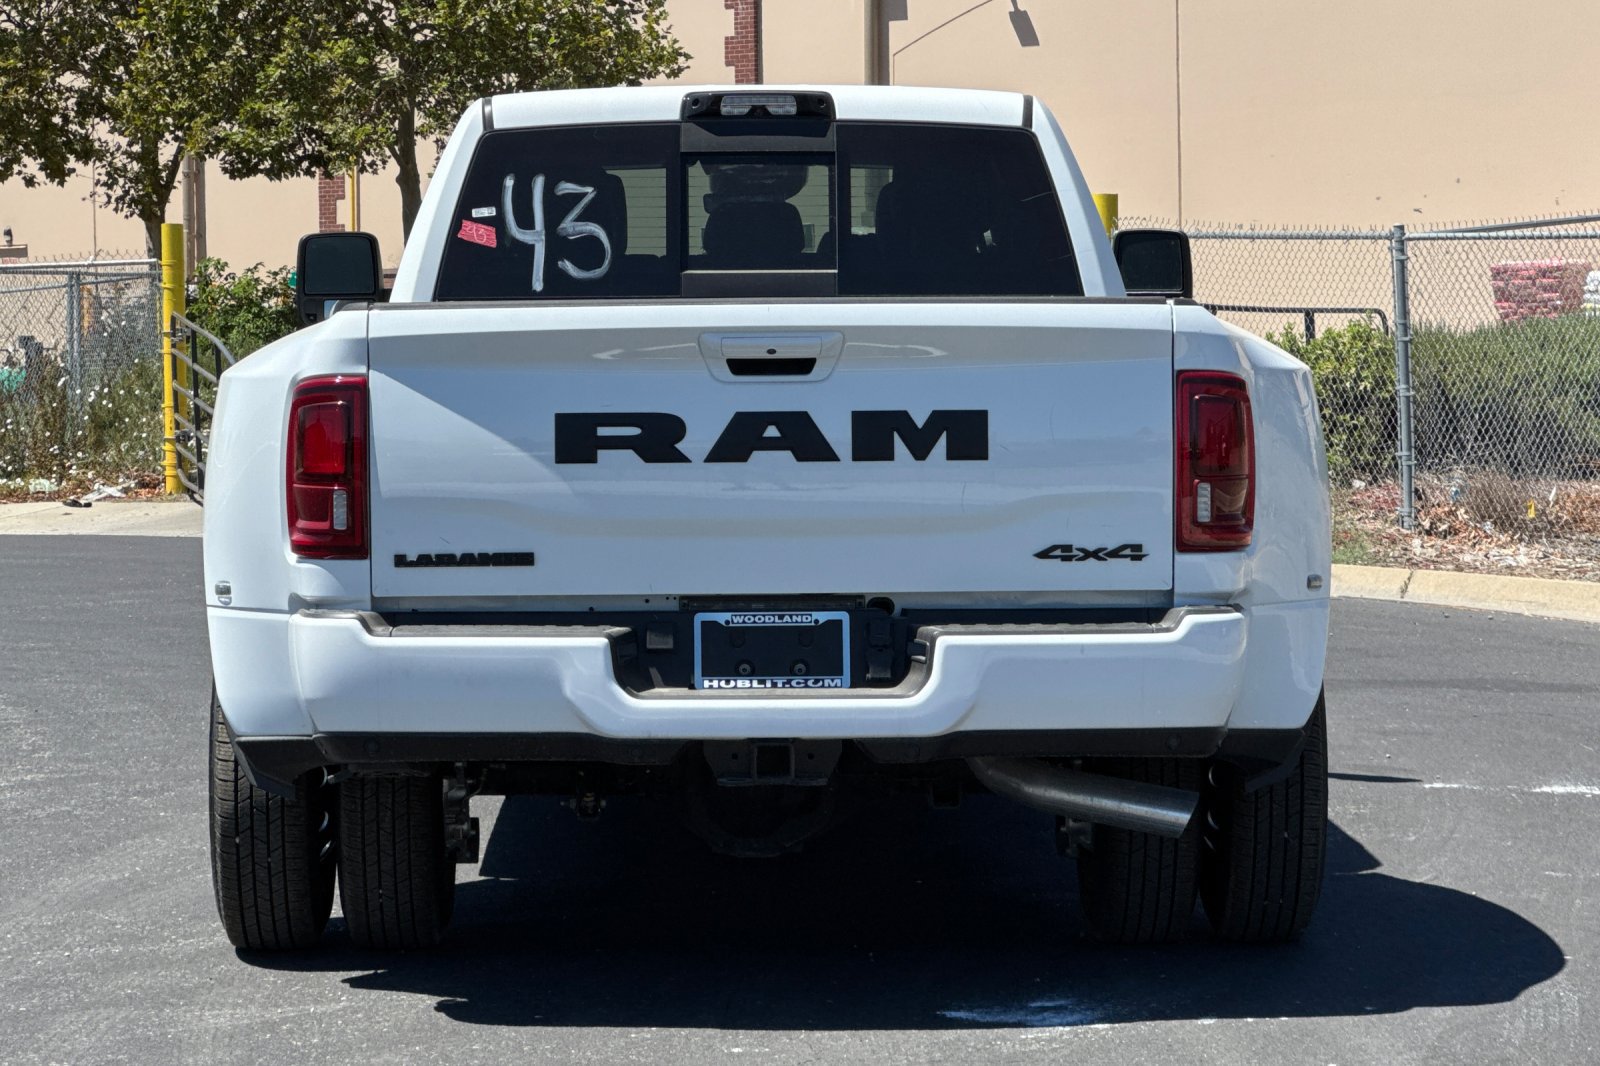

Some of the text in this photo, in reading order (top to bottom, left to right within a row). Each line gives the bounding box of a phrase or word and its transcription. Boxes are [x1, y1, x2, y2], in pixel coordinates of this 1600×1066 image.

[502, 173, 612, 292] 43
[555, 409, 989, 464] RAM
[1033, 544, 1150, 562] 4x4
[731, 614, 812, 624] WOODLAND
